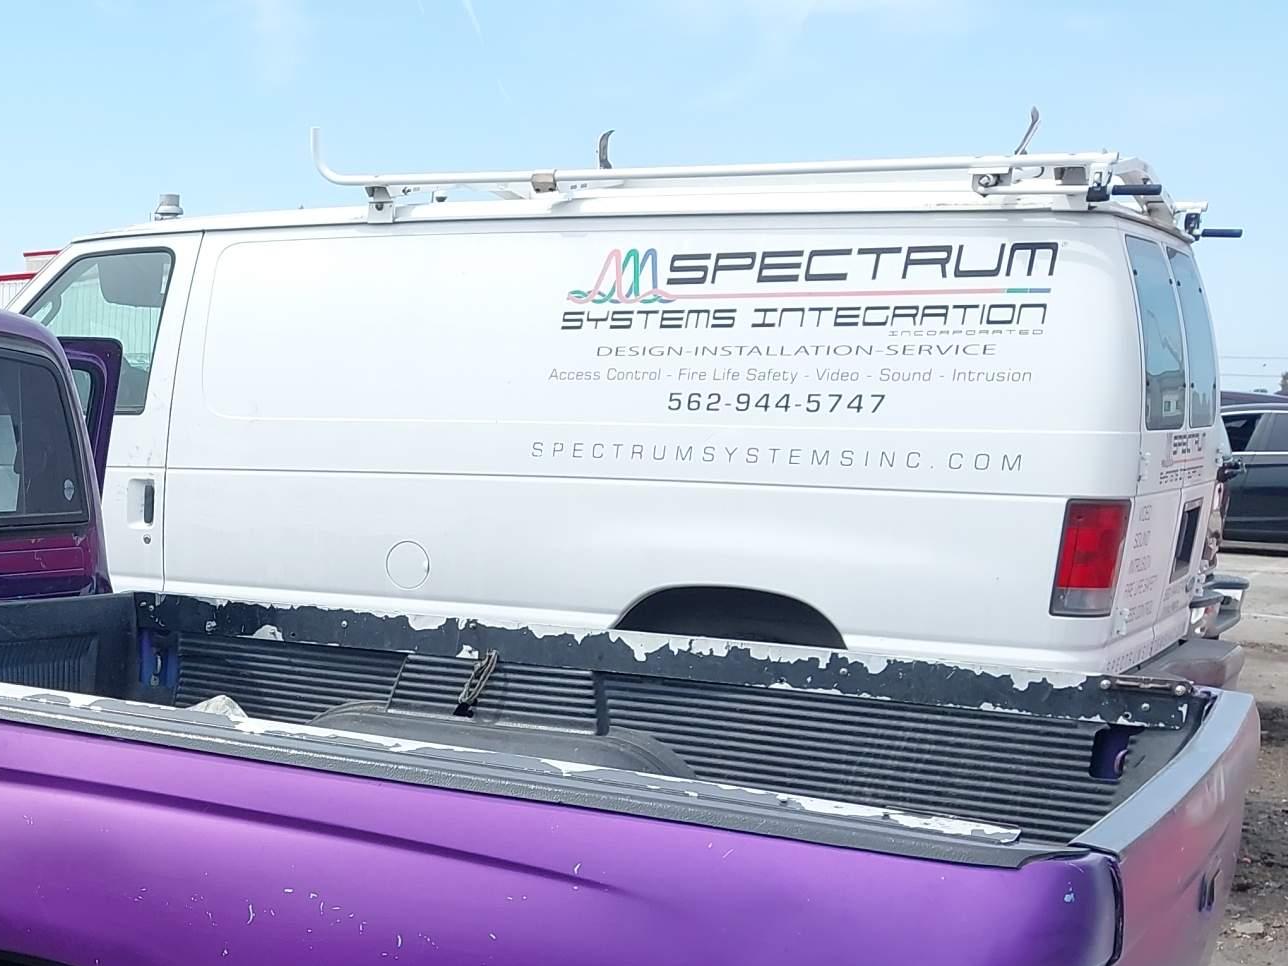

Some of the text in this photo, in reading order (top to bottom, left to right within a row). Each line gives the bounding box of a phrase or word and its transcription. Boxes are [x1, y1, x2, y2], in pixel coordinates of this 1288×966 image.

[666, 241, 1059, 286] SPECTRUM
[561, 303, 1048, 330] SYSTEMS INTEGRATION
[888, 329, 1044, 337] INCORPORATED
[596, 343, 997, 357] DESIGN-INSTALLATION-SERVICE
[548, 368, 601, 382] Access
[606, 367, 661, 381] Control
[678, 368, 707, 382] Fire
[712, 368, 740, 382] Life
[745, 368, 799, 385] Safety
[815, 368, 860, 382] Video
[879, 368, 932, 383] Sound
[952, 368, 1032, 383] Intrusion
[667, 392, 886, 413] 562-944-5747
[531, 441, 1023, 472] SPECTRUMSYSTEMSINC.COM
